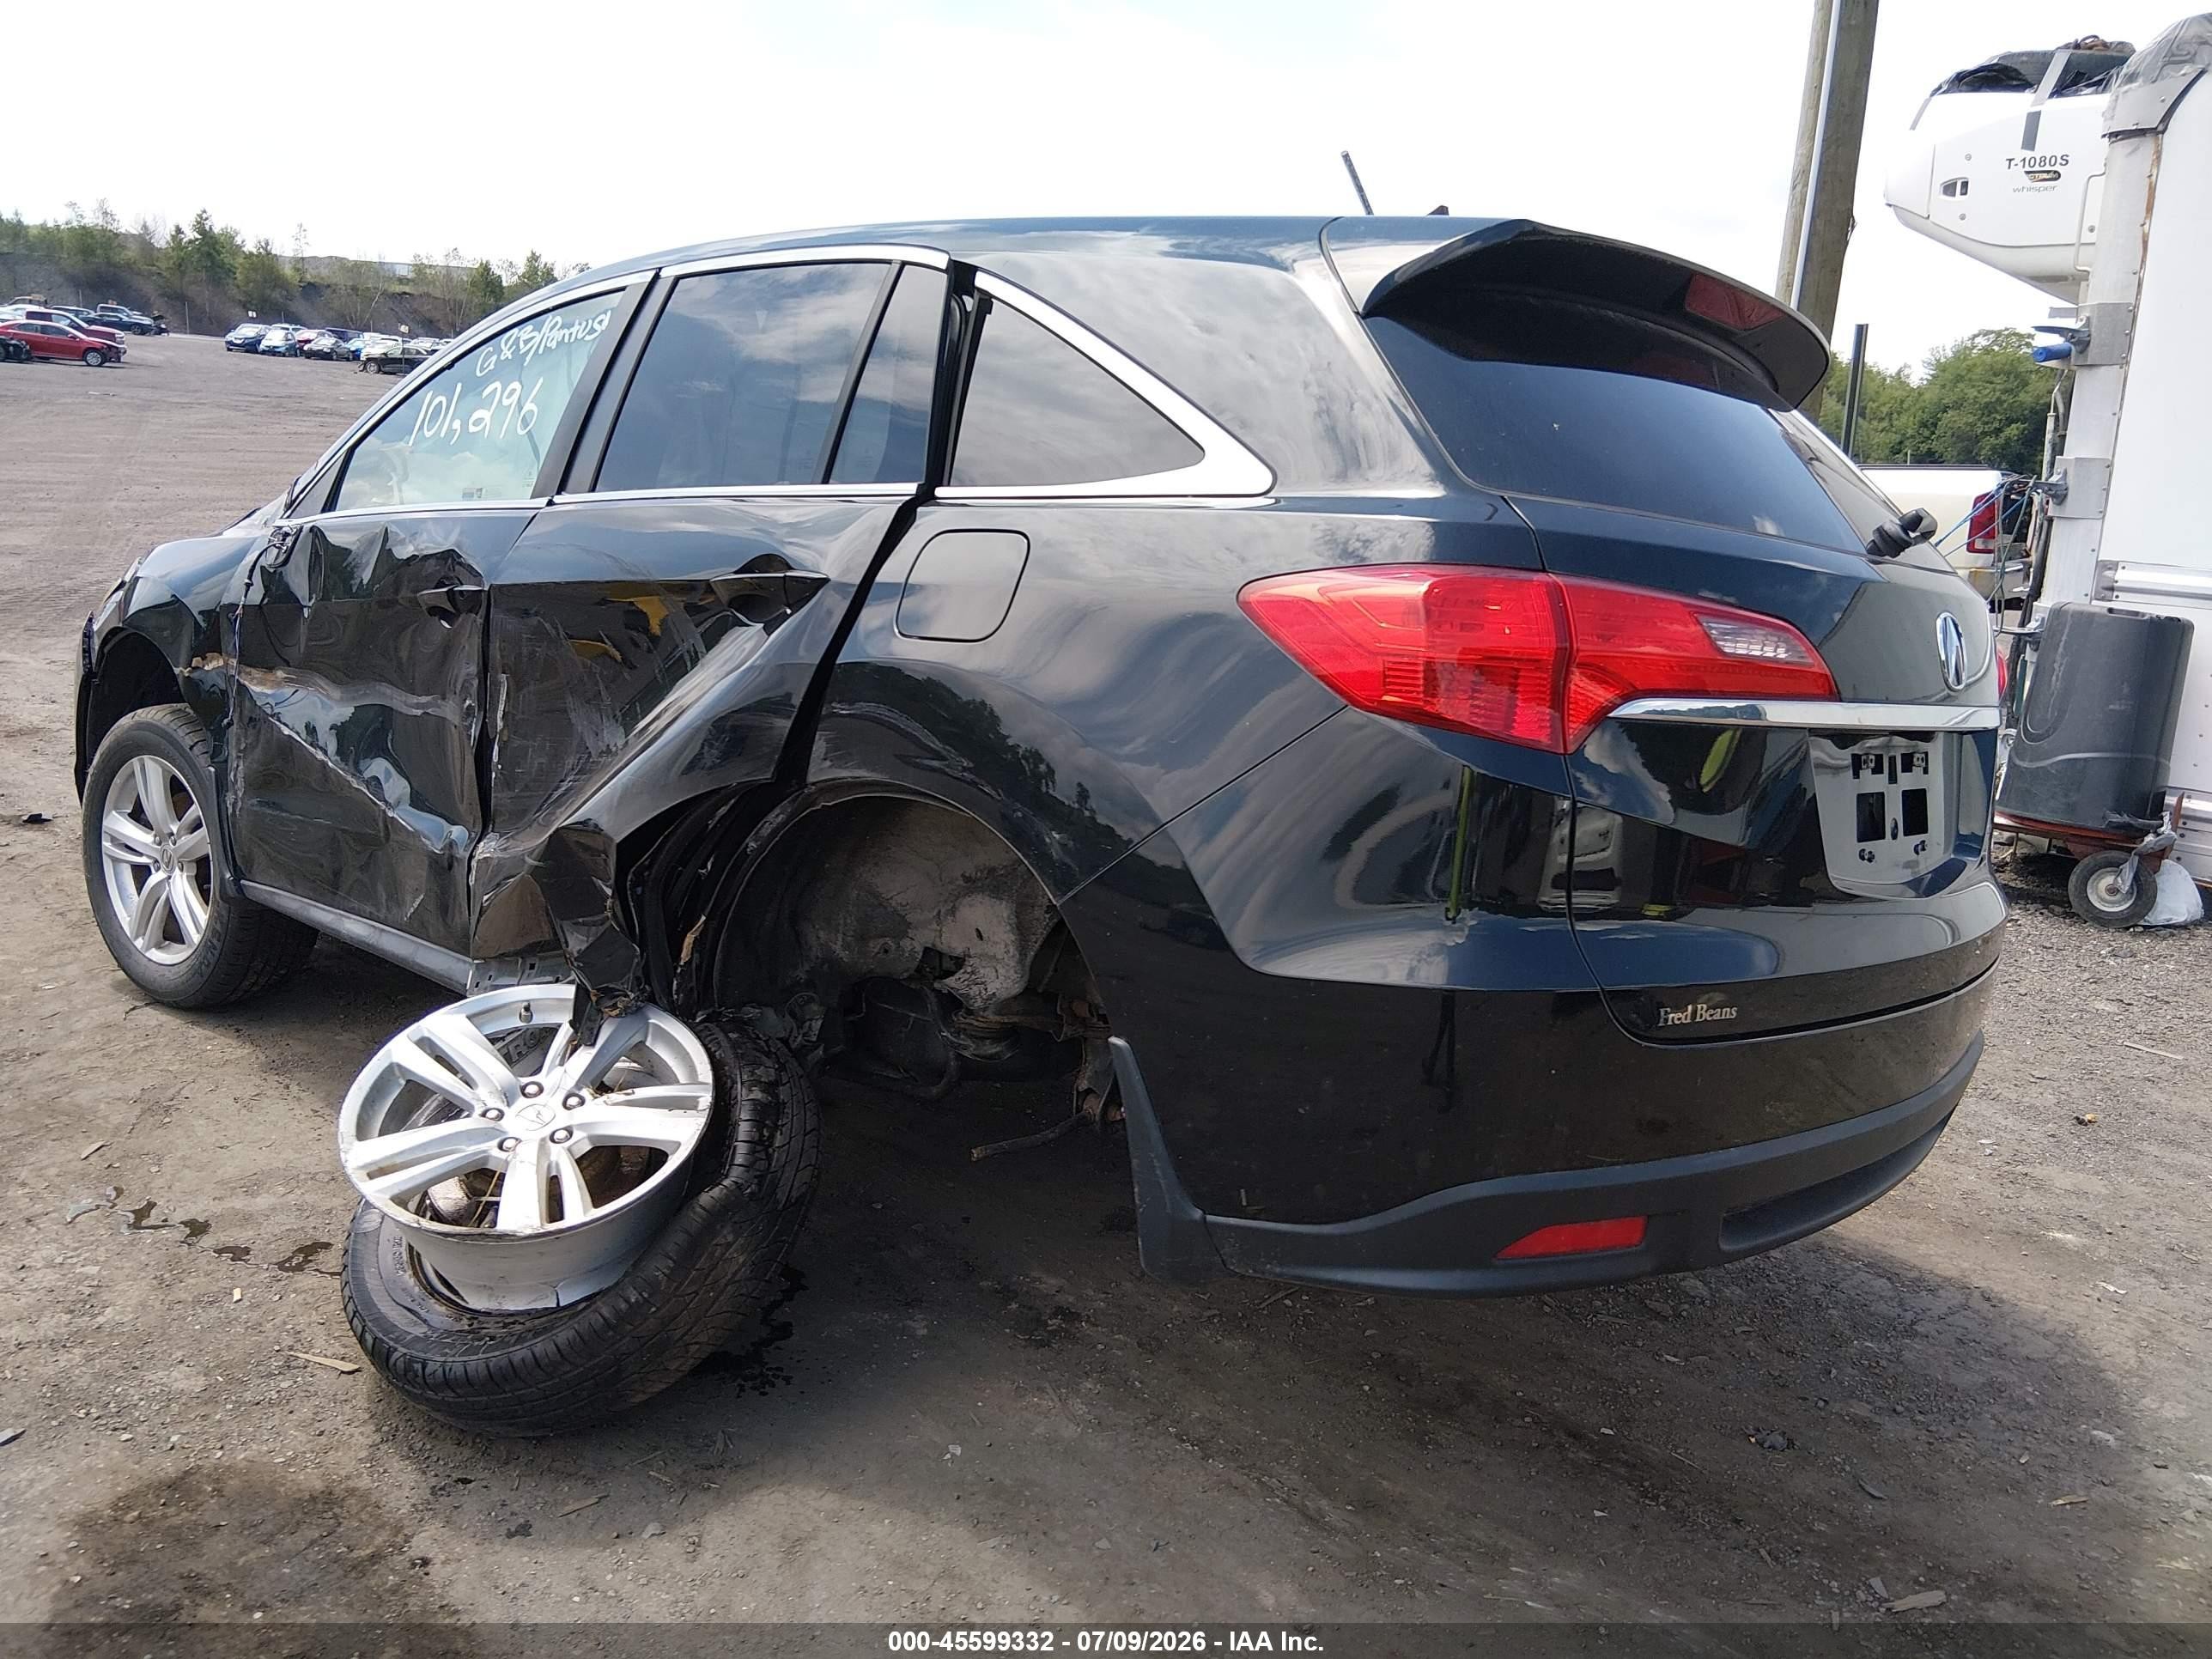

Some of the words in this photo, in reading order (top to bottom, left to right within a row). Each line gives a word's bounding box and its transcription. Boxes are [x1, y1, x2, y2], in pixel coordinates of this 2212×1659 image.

[2005, 154, 2070, 170] T-1080S
[2012, 185, 2058, 193] whisper
[408, 376, 544, 447] 101,296
[1657, 1004, 1692, 1027] Fred
[1695, 1003, 1738, 1022] Beans
